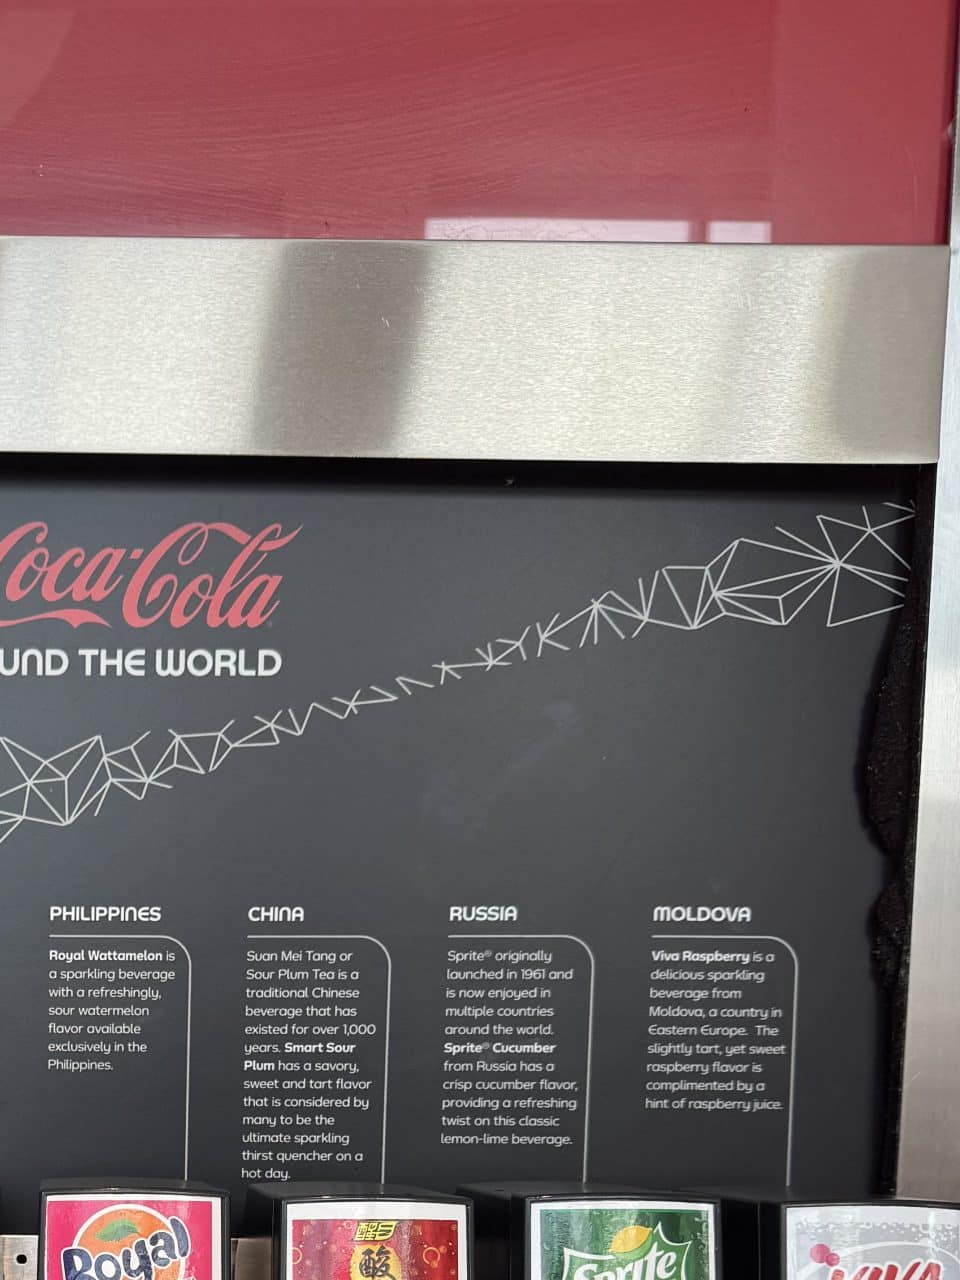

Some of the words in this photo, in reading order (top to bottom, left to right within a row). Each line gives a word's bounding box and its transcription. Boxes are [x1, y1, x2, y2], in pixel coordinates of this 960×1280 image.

[78, 649, 146, 677] THE
[155, 649, 283, 678] WORLD
[49, 905, 162, 922] PHILIPPINES
[247, 905, 305, 922] CHINA
[448, 905, 518, 922] RUSSIA
[652, 905, 752, 923] MOLDOVA
[494, 950, 552, 964] originally
[49, 970, 57, 979] a
[60, 968, 116, 982] sparkling
[118, 968, 176, 982] beverage
[650, 969, 705, 980] delicious
[707, 969, 765, 983] sparkling
[48, 986, 74, 998] with
[76, 989, 85, 998] a
[88, 986, 162, 1001] refreshingly,
[246, 986, 309, 998] traditional
[311, 987, 360, 999] Chinese
[649, 987, 710, 1002] beverage
[711, 987, 742, 999] from
[48, 1007, 75, 1016] sour
[78, 1004, 149, 1016] watermelon
[245, 1005, 303, 1019] beverage
[305, 1005, 332, 1017] that
[334, 1005, 357, 1017] has
[445, 1005, 495, 1019] multiple
[496, 1006, 554, 1017] countries
[48, 1022, 84, 1034] flavor
[86, 1023, 141, 1034] available
[244, 1023, 288, 1035] existed
[291, 1023, 310, 1035] for
[312, 1026, 340, 1035] over
[342, 1024, 376, 1037] 1,000
[648, 1024, 698, 1035] Eastern
[700, 1024, 748, 1039] Europe.
[754, 1025, 779, 1036] The
[244, 1044, 281, 1056] years.
[284, 1042, 324, 1053] Smart
[325, 1042, 356, 1053] Sour
[492, 1042, 557, 1053] Cucumber
[647, 1042, 693, 1057] slightly
[695, 1044, 723, 1056] tart,
[725, 1044, 747, 1057] yet
[749, 1045, 786, 1055] sweet
[48, 1058, 113, 1073] Philippines.
[646, 1061, 710, 1075] raspberry
[712, 1061, 750, 1073] flavor
[751, 1062, 763, 1073] is
[442, 1079, 473, 1092] crisp
[475, 1079, 537, 1090] cucumber
[539, 1078, 578, 1092] flavor,
[242, 1131, 291, 1143] ultimate
[294, 1132, 350, 1146] sparkling
[440, 1133, 509, 1144] lemon-lime
[511, 1133, 573, 1147] beverage.
